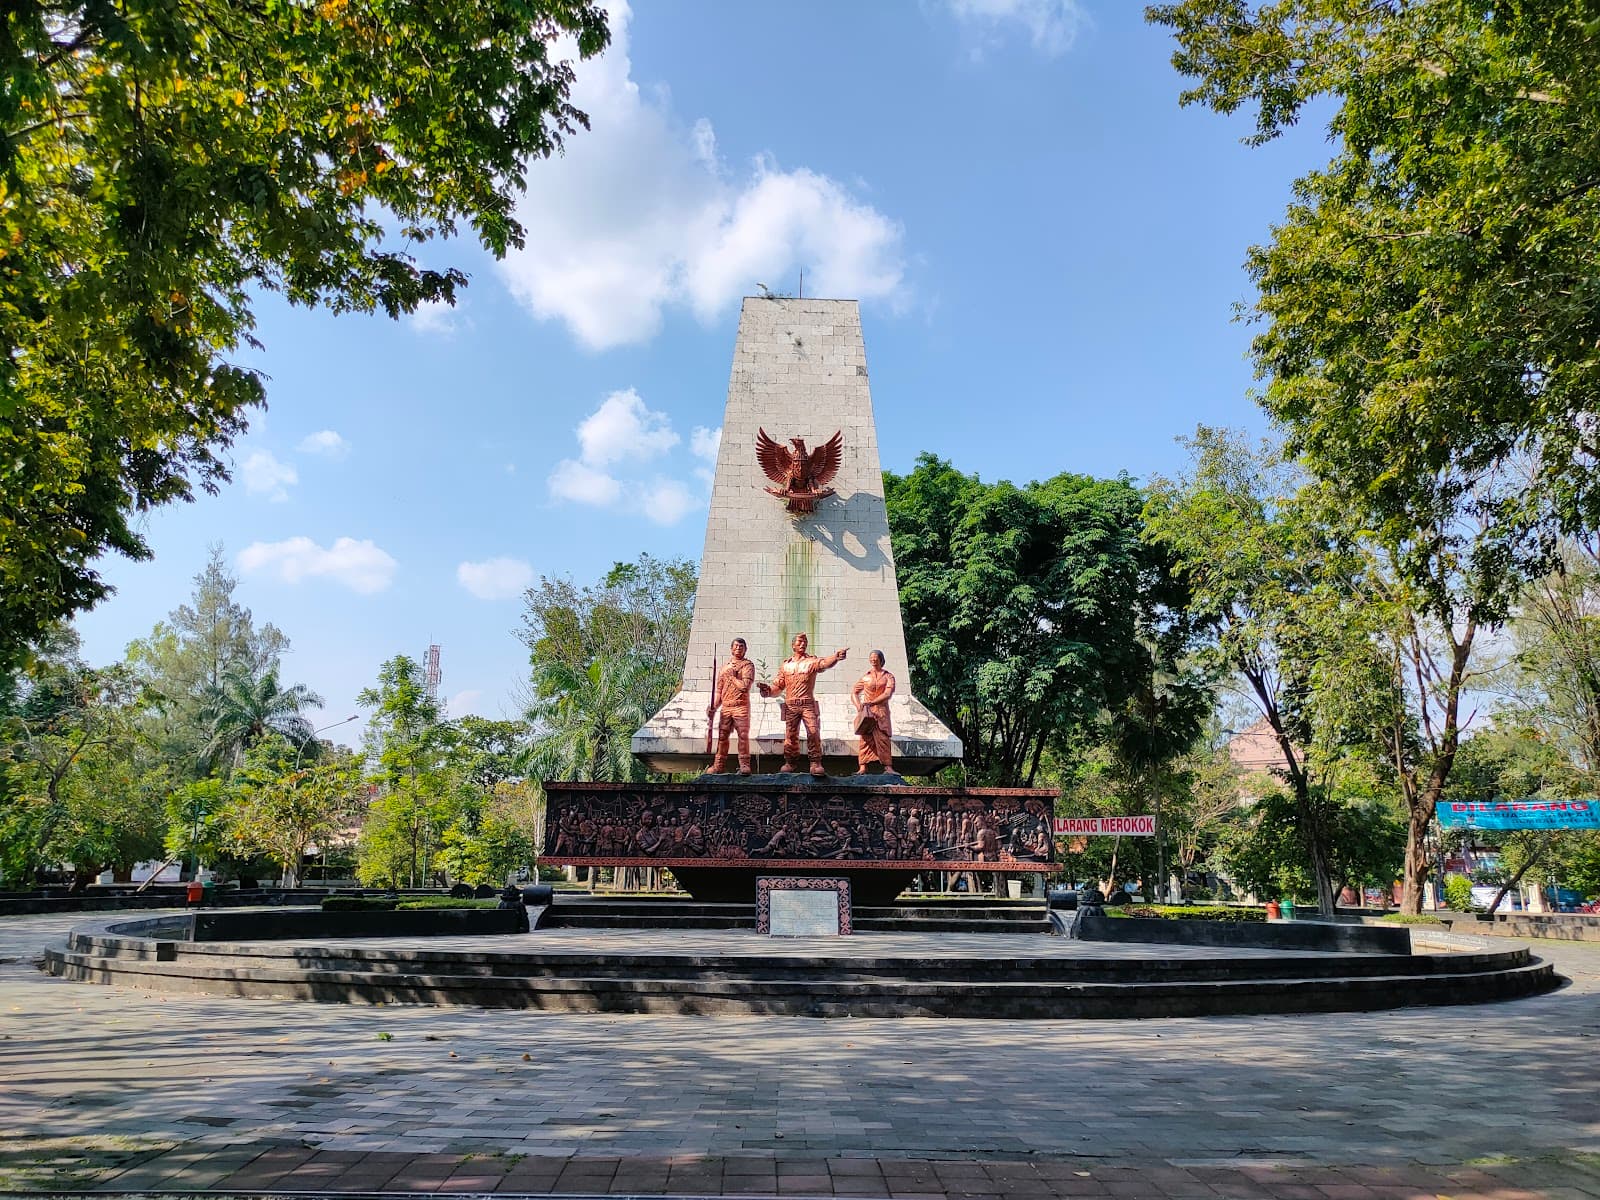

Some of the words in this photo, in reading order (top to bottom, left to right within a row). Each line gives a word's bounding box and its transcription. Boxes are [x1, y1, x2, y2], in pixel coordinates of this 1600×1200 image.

[1452, 802, 1588, 812] DILARANG
[1053, 818, 1098, 833] ILARANG
[1101, 817, 1154, 833] MEROKOK
